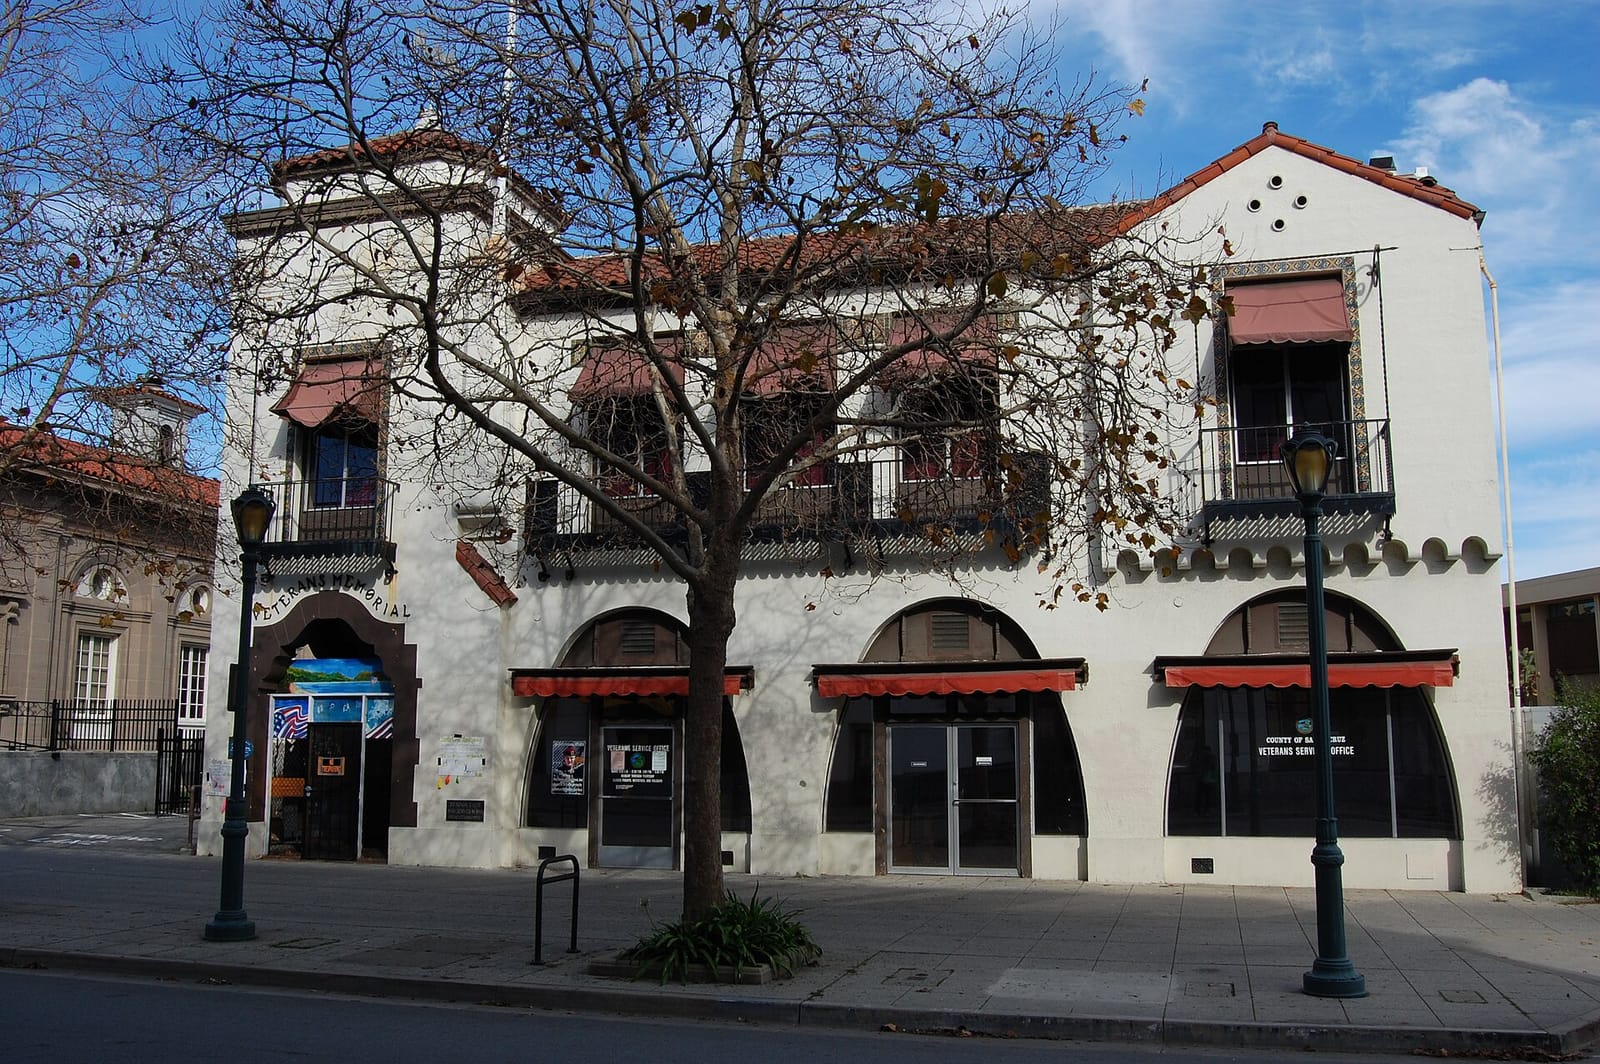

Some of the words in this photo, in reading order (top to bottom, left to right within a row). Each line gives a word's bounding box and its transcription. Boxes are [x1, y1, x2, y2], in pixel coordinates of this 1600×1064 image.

[253, 575, 326, 621] VETERANS
[332, 574, 411, 619] MEMORIAL
[1266, 736, 1292, 744] COUNTY
[1294, 736, 1303, 744] OF
[1259, 746, 1294, 756] VETERANS
[1295, 746, 1315, 756] SERVI
[1330, 746, 1355, 755] OFFICE
